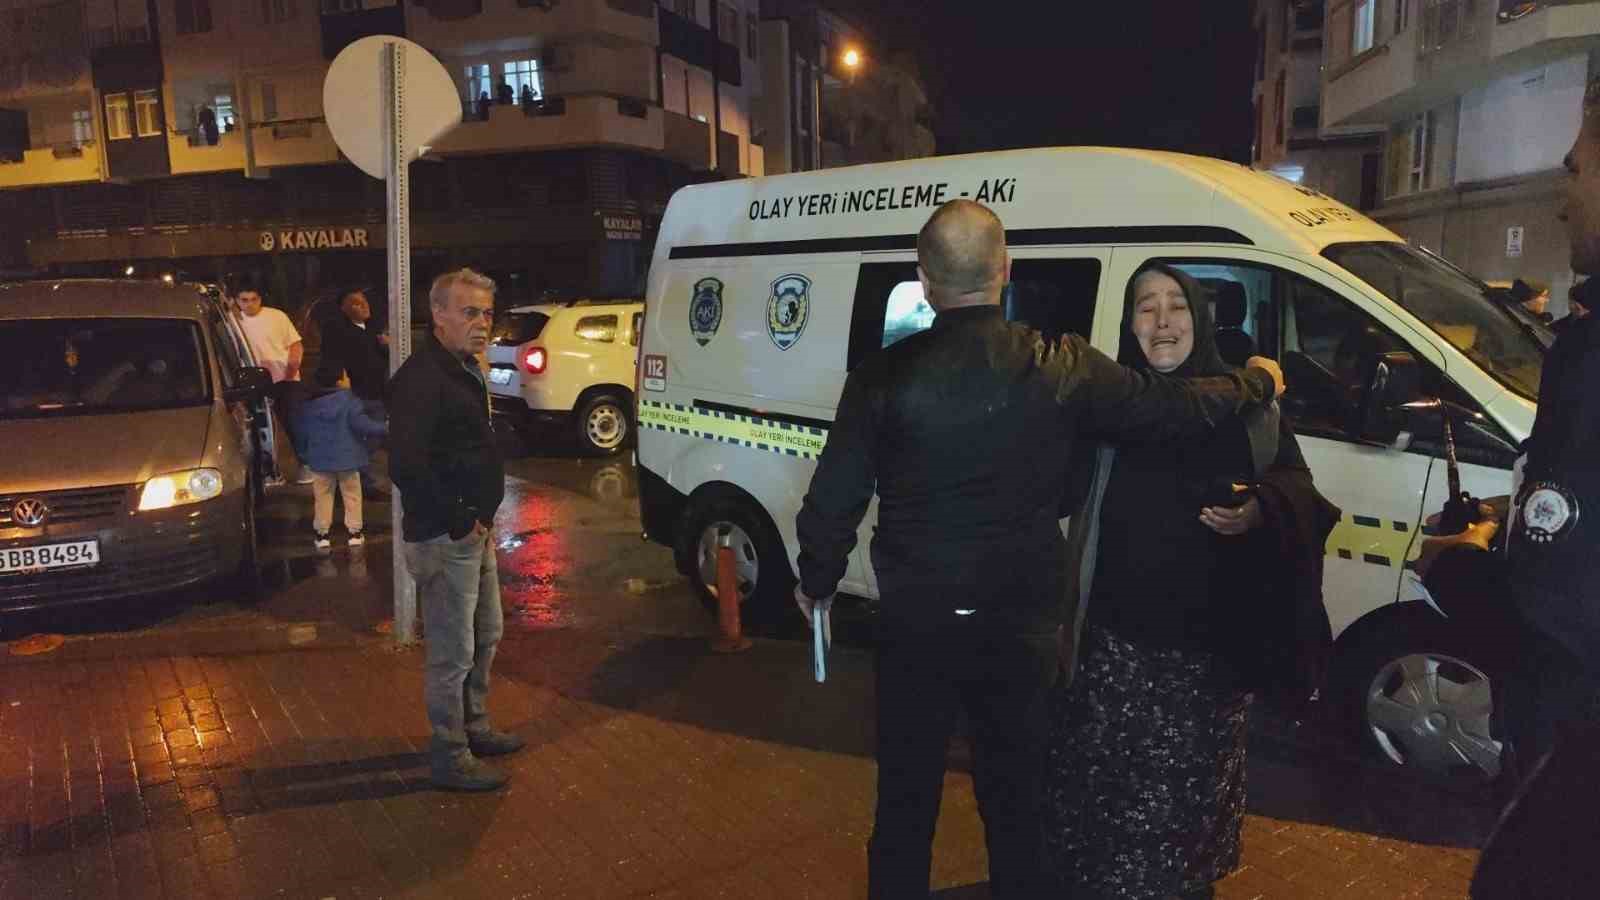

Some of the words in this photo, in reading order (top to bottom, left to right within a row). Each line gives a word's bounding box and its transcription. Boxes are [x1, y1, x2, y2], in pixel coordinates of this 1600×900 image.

[749, 197, 794, 220] OLAY
[280, 229, 368, 249] KAYALAR
[647, 359, 664, 377] 112
